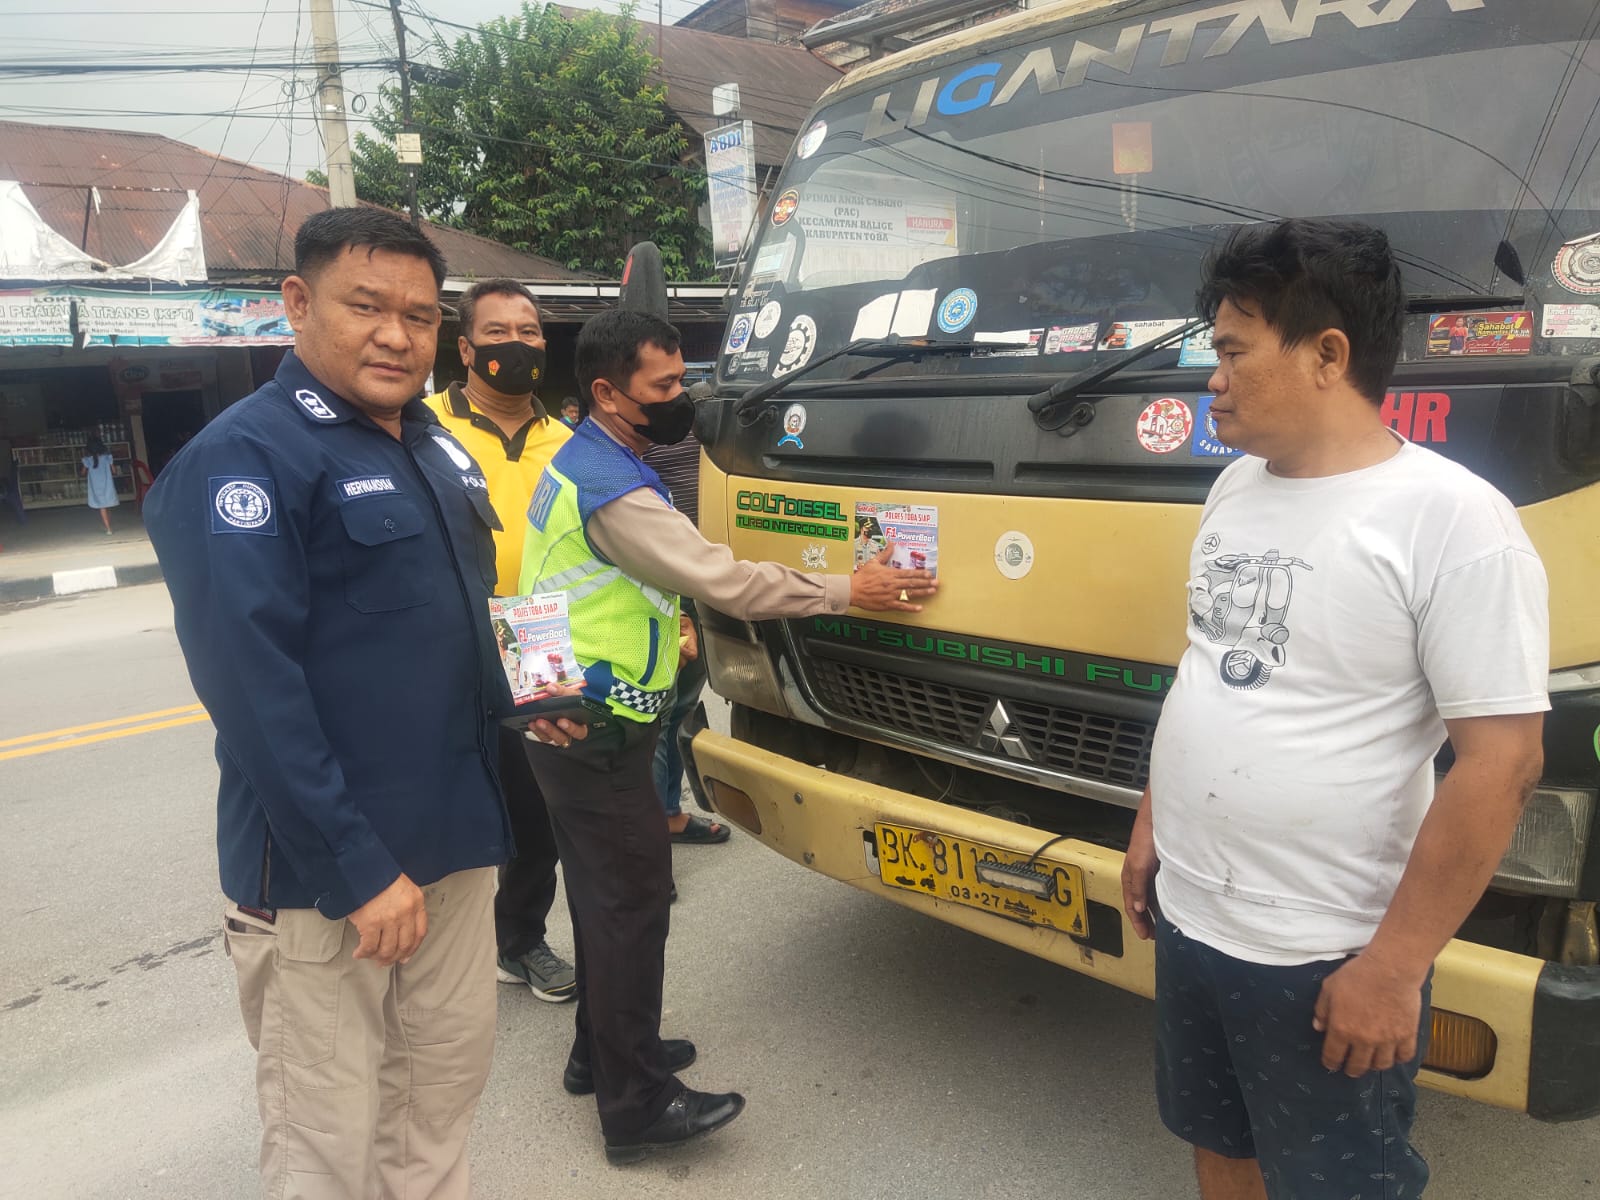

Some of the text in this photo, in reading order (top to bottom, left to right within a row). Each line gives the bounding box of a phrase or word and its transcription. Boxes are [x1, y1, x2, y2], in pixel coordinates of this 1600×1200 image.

[710, 130, 743, 154] ABDI
[834, 207, 860, 219] (PAC)
[800, 216, 858, 229] KECAMATAN
[912, 218, 945, 228] HANURA
[806, 230, 889, 242] KABUPATEN TOBA
[9, 304, 195, 321] PRATAA TRANS (KPT)
[1479, 322, 1515, 331] Sahabat
[1199, 439, 1239, 455] SAHAB
[736, 490, 848, 522] COLT DIESEL
[885, 511, 931, 522] POLRES TOBA SIAP
[736, 516, 848, 539] TURBO INTERCOOLER
[886, 527, 897, 539] F1
[897, 531, 935, 543] PowerBoat
[543, 602, 558, 615] SIAP
[518, 627, 528, 643] F1
[527, 627, 567, 642] PowerBoat
[815, 618, 1065, 676] MITSUBISHI
[882, 828, 919, 869] BK
